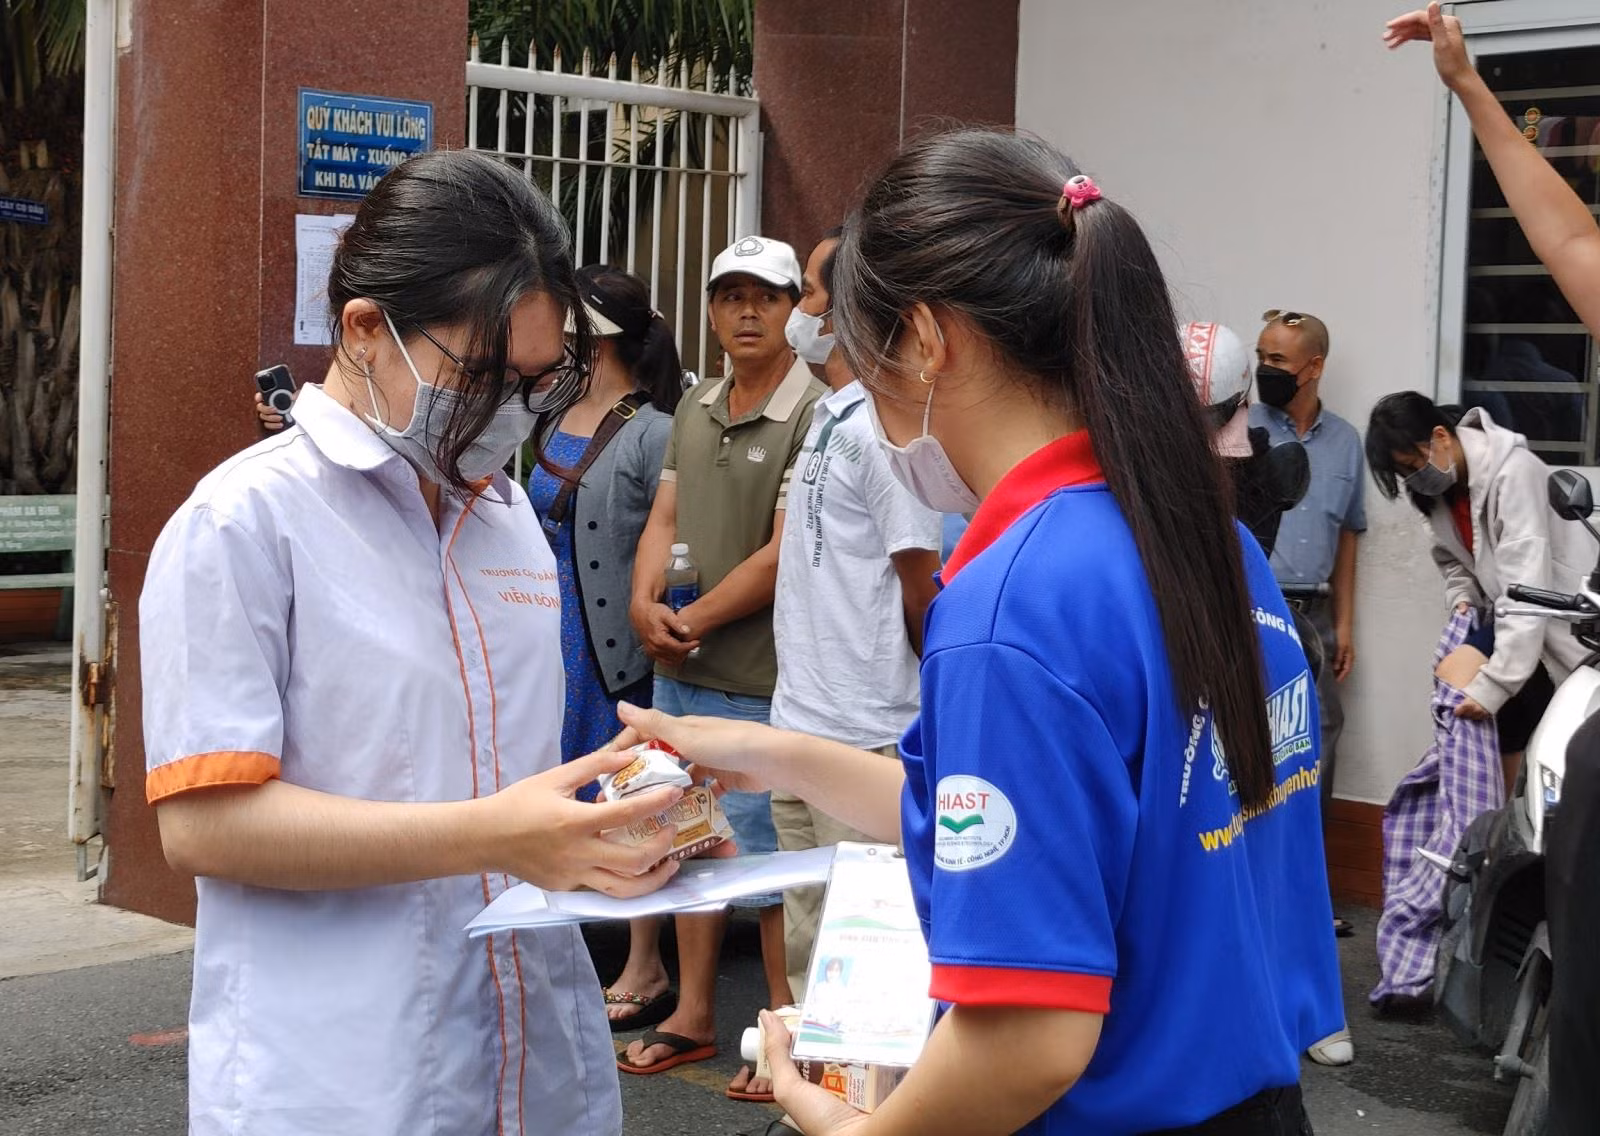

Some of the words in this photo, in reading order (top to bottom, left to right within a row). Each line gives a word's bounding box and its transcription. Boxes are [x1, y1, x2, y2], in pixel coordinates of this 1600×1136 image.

[307, 101, 330, 130] QUÝ
[333, 104, 372, 135] KHÁCH
[376, 113, 395, 137] VUI
[397, 110, 426, 140] LÒNG
[332, 142, 358, 162] MÁY
[315, 171, 336, 188] KHI
[339, 173, 355, 189] RA
[820, 455, 832, 482] WORLD
[815, 483, 825, 514] FAMOUS
[812, 541, 822, 568] BRAND
[1265, 675, 1308, 747] HIAST
[938, 792, 990, 811] HIAST
